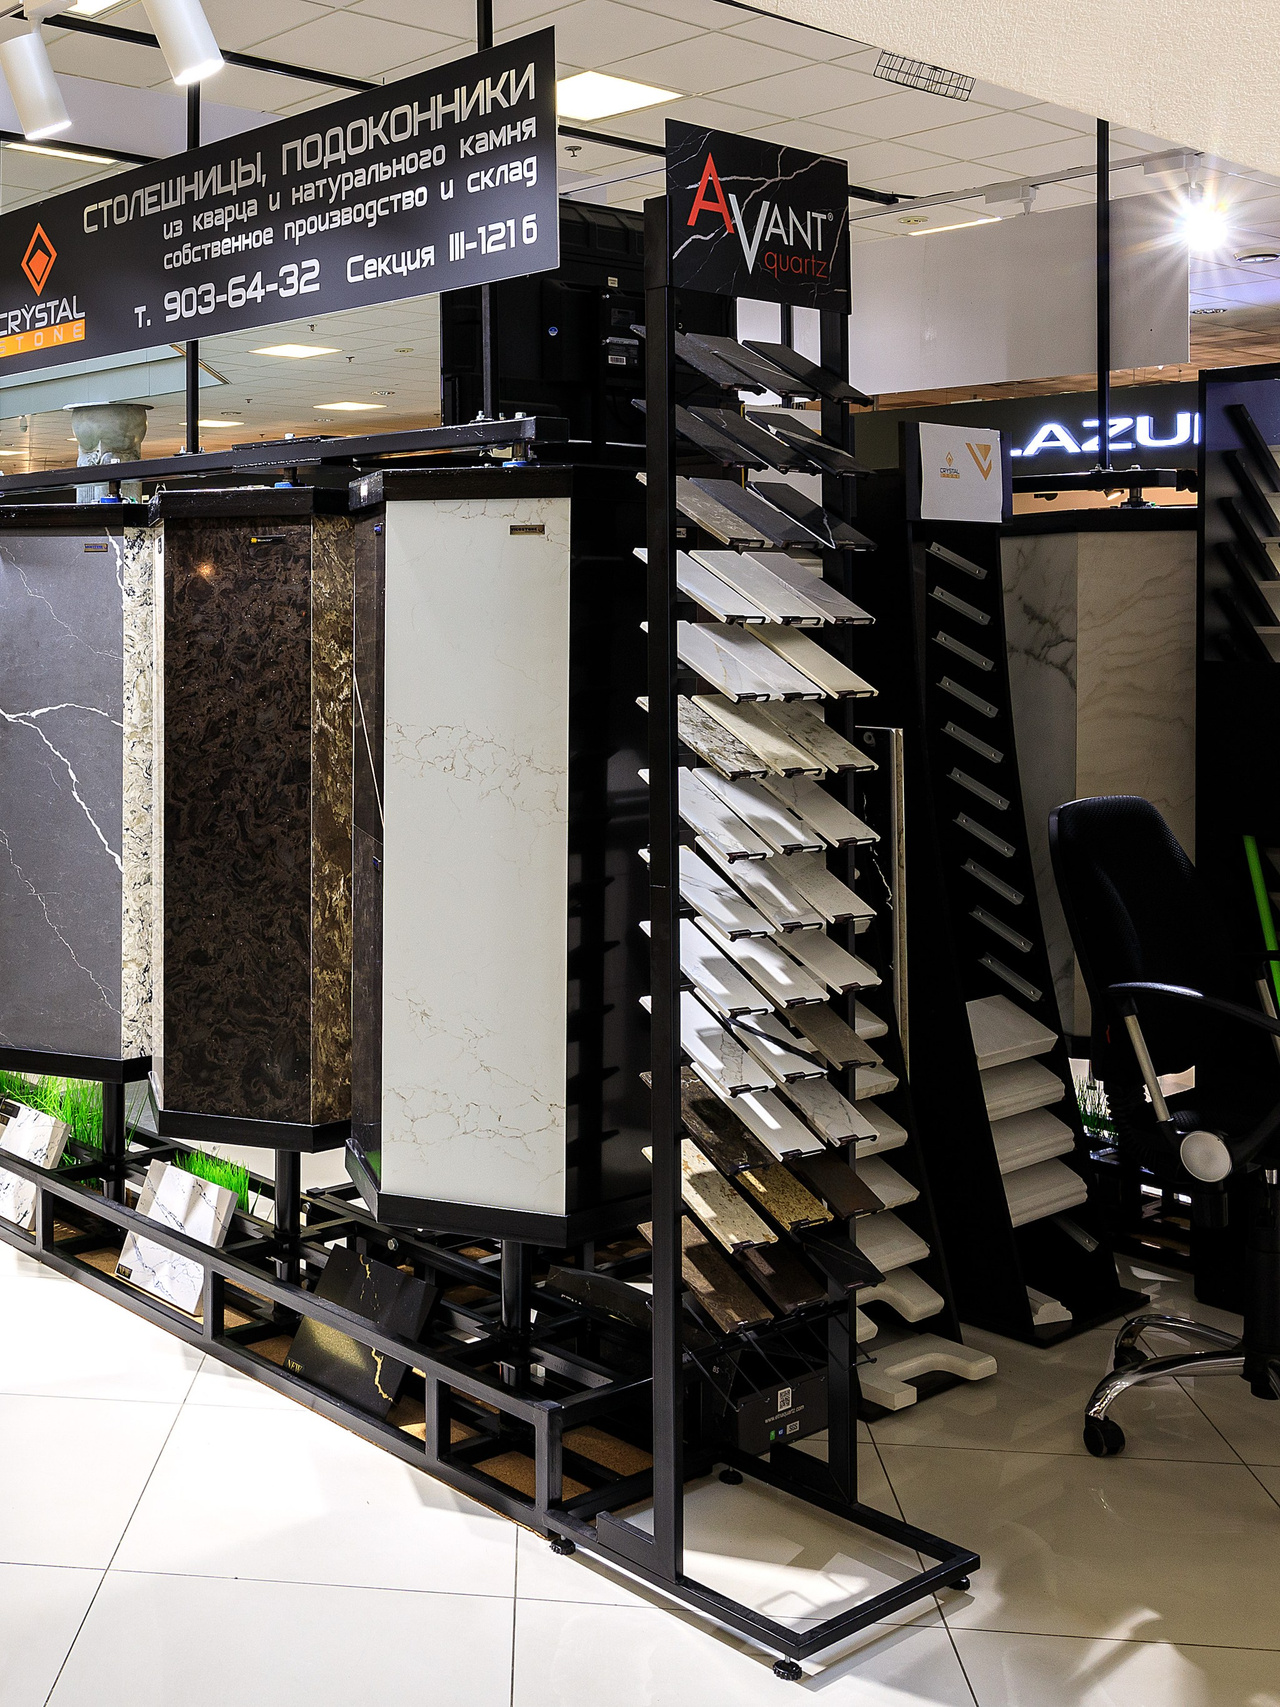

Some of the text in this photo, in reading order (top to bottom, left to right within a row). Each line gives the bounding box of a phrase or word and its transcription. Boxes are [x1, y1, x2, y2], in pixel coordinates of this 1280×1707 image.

[83, 62, 535, 234] СТОЛЕШНИЦЫ, ПОДОКОННИКИ
[163, 116, 537, 240] из кварца и натурального камня
[163, 155, 537, 270] собственное производство и склад
[134, 305, 151, 328] т.
[163, 258, 320, 323] 903-64-32
[346, 244, 435, 283] Секция
[764, 251, 828, 279] quartz
[1010, 412, 1200, 457] AZU
[287, 1359, 303, 1373] NEW
